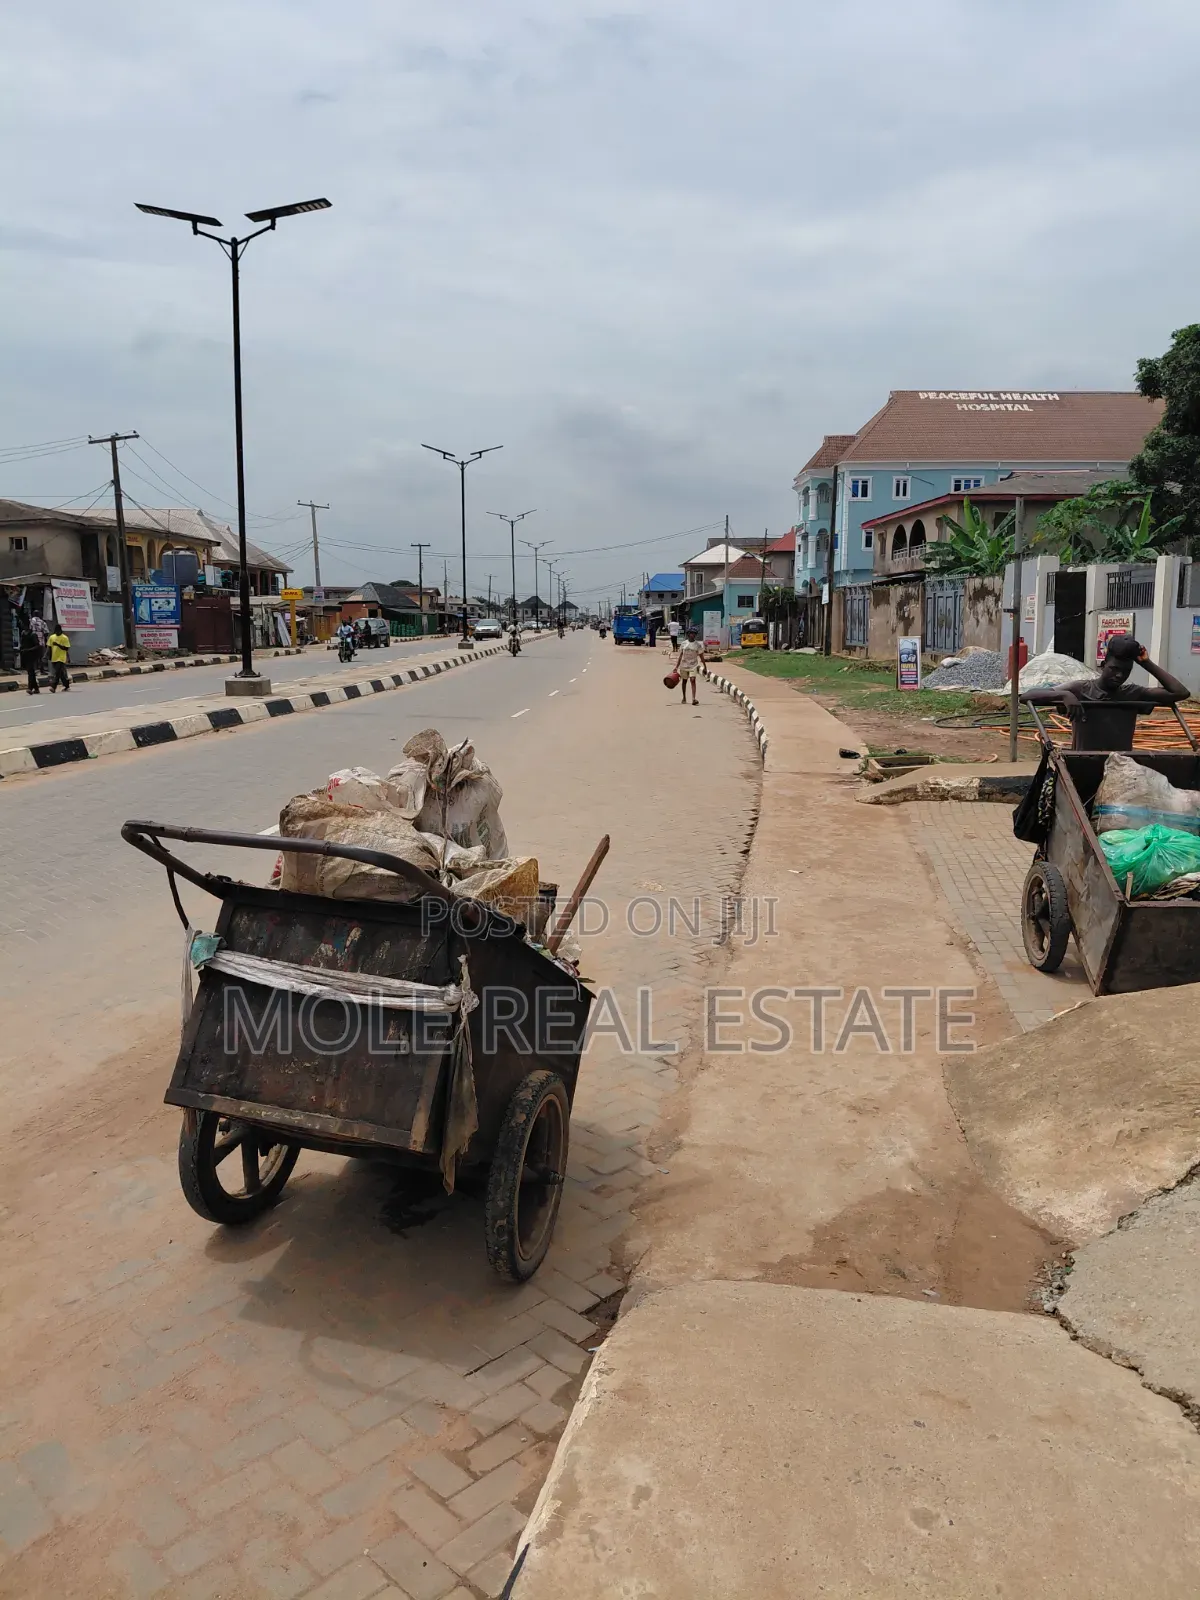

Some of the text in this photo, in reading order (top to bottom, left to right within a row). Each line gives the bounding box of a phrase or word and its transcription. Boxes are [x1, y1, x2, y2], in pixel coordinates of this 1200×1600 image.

[918, 392, 1060, 400] PEACEFUL HEALTH
[956, 404, 1034, 412] HOSPITAL
